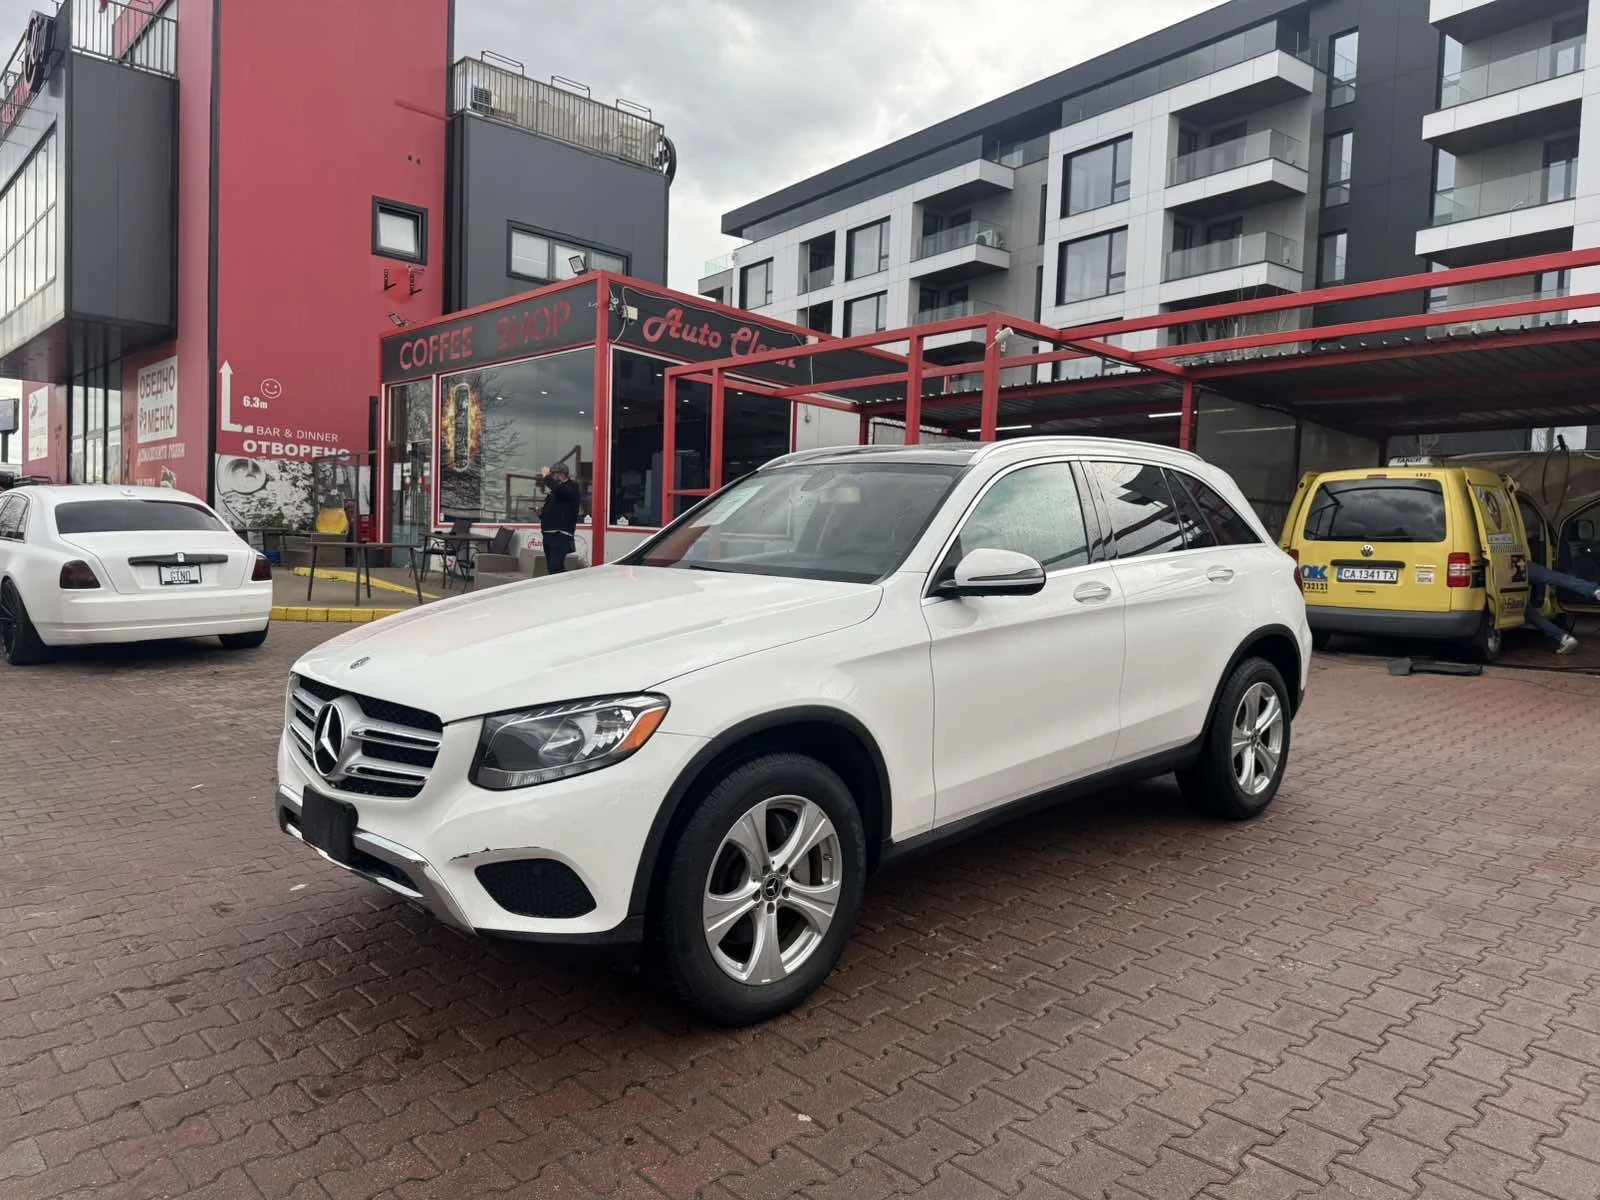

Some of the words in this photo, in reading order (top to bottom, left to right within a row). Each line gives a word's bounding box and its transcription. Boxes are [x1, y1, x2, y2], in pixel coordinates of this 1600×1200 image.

[400, 325, 474, 371] COFFEE
[496, 301, 571, 350] SHOP
[642, 306, 722, 349] Auto
[139, 365, 176, 400] ОБЕДНО
[256, 425, 280, 438] BAR
[284, 428, 293, 438] &
[297, 430, 339, 443] DINNER
[1343, 569, 1356, 579] CA
[1359, 569, 1381, 580] 1341
[1383, 570, 1395, 581] TX
